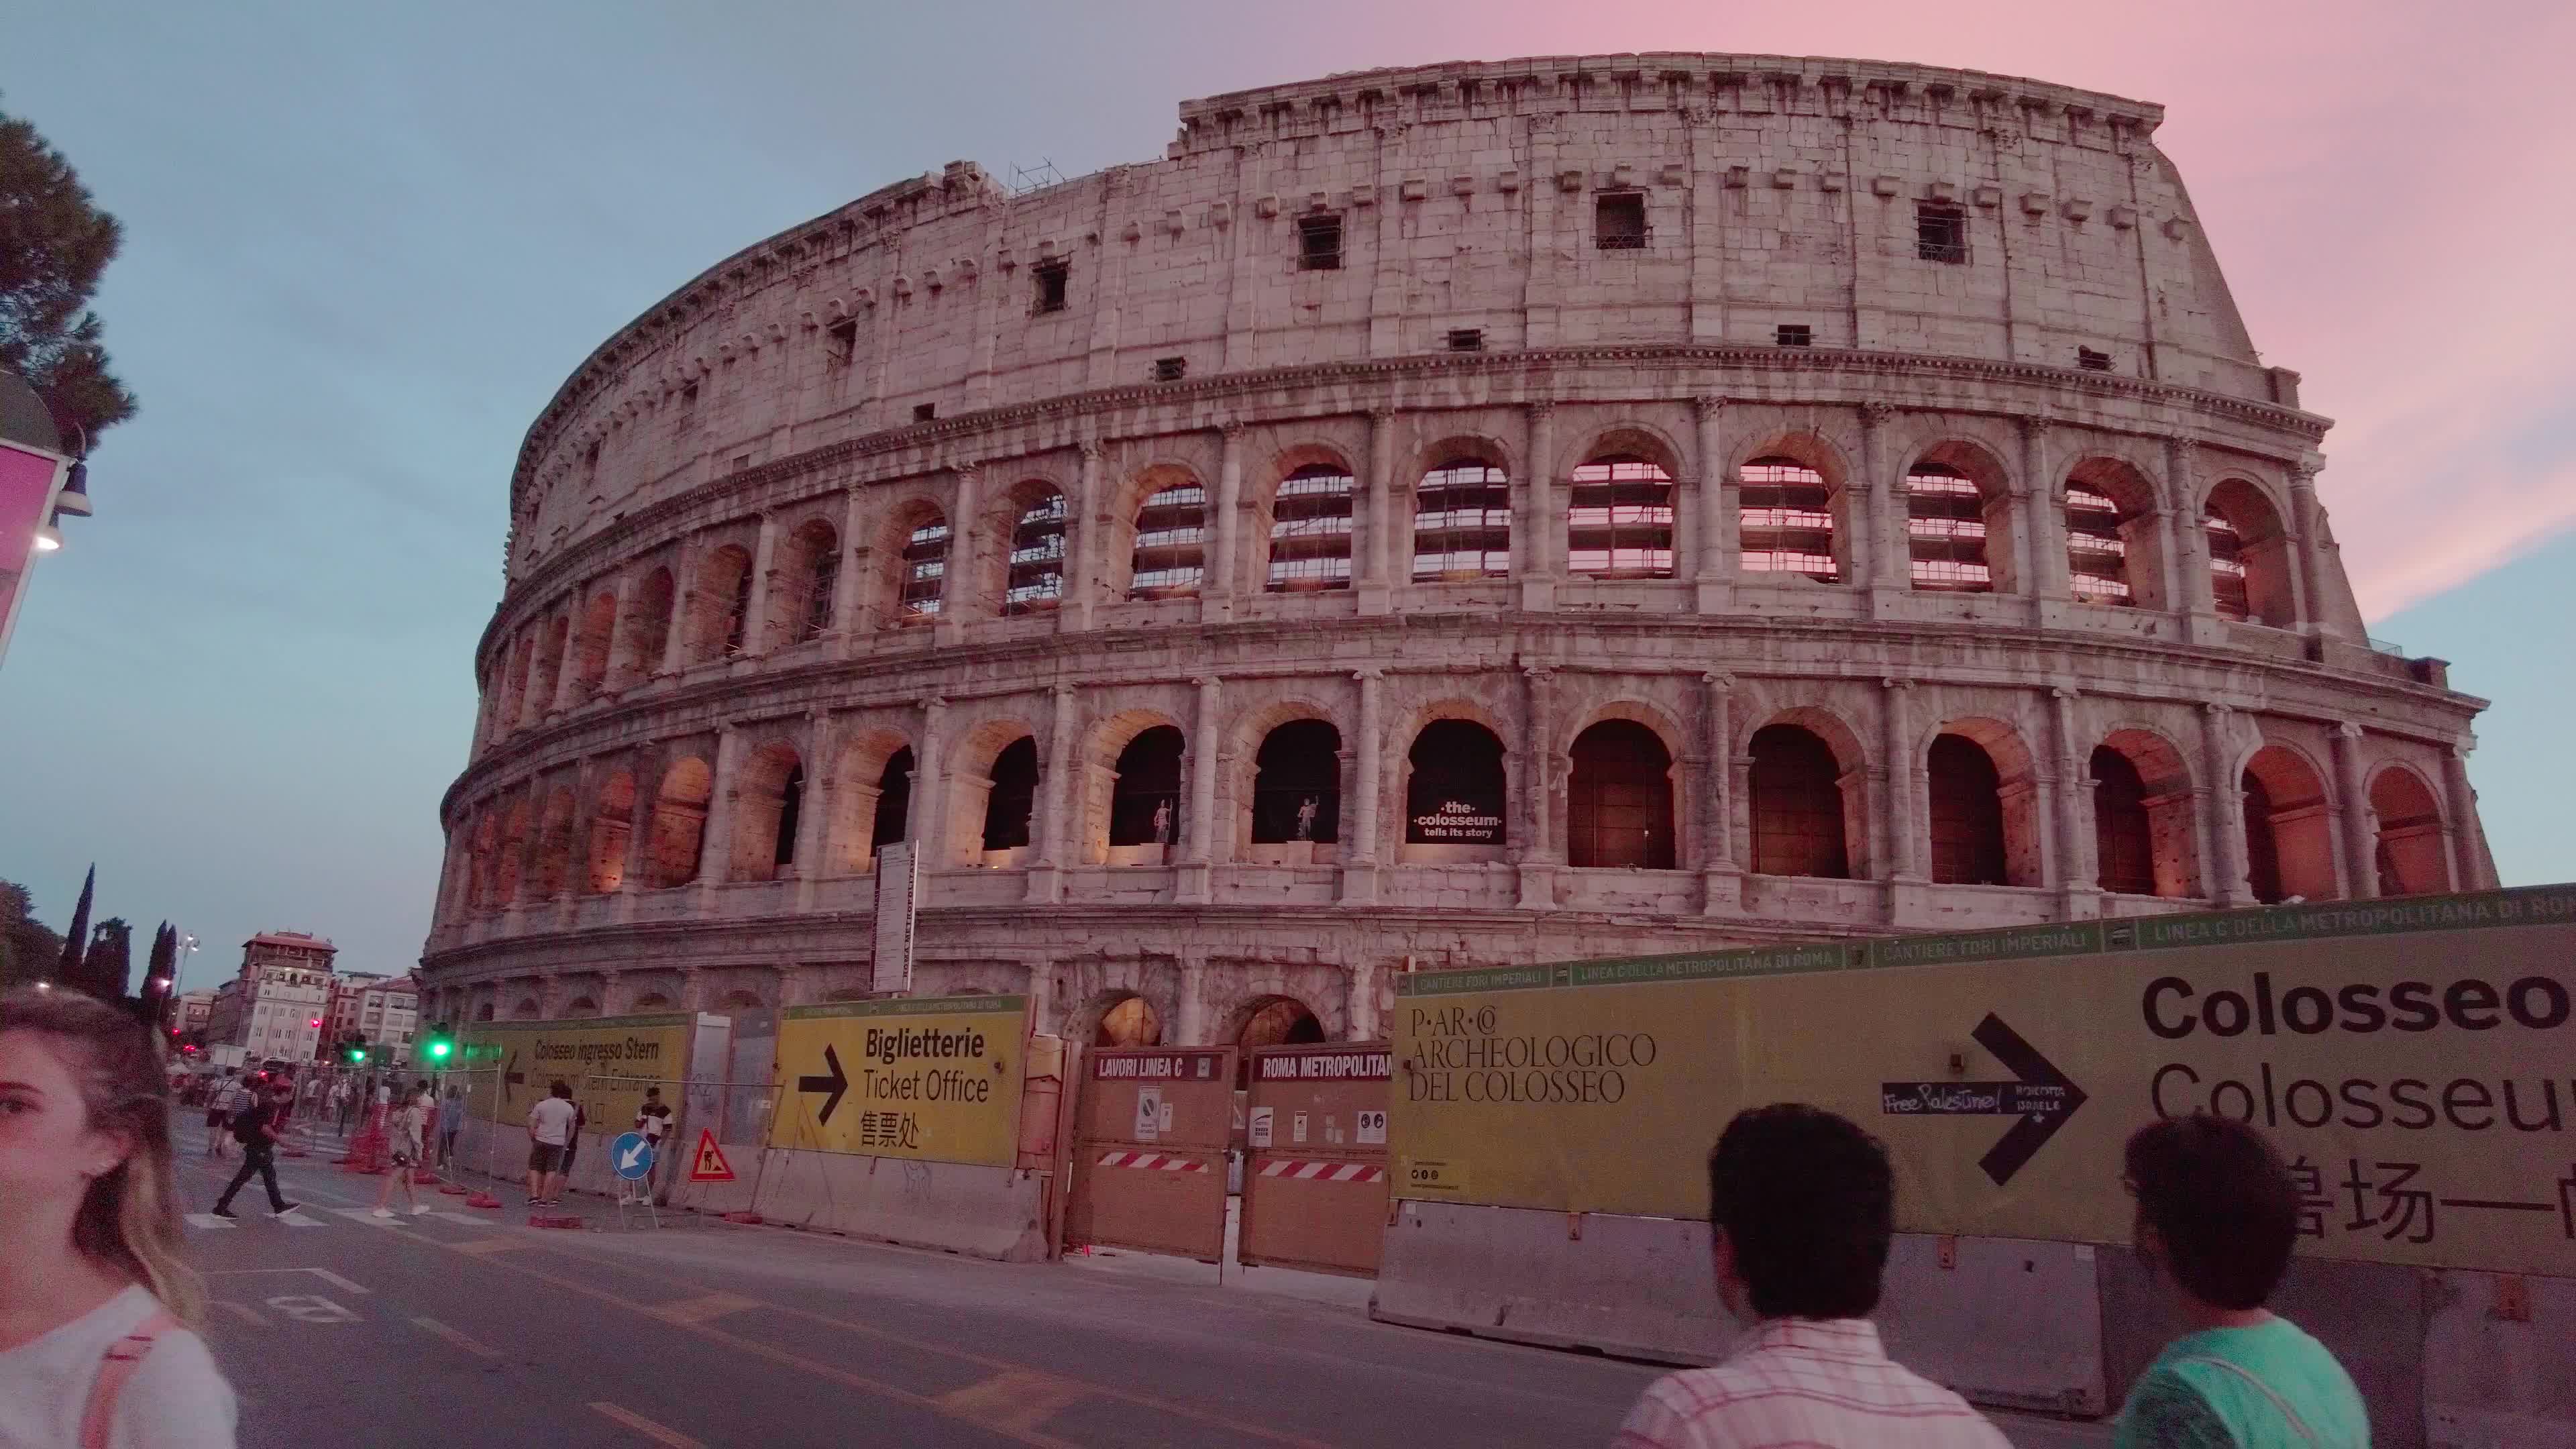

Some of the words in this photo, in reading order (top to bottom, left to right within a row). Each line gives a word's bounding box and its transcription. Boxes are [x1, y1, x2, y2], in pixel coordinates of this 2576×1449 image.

[1424, 828, 1447, 837] tells
[1449, 828, 1463, 837] its
[1465, 828, 1493, 839] story
[2154, 922, 2210, 941] LINEA
[2233, 912, 2298, 934] DELLA
[2300, 902, 2491, 932] METROPOLITANA
[2498, 900, 2523, 918] DI
[1884, 942, 1959, 962] CANTIERE
[1960, 938, 1996, 955] FORI
[2001, 933, 2086, 952] IMPERIALI
[1580, 965, 1614, 980] LINEA
[1627, 961, 1664, 977] DELLA
[1666, 955, 1772, 977] METROPOLITANA
[1776, 953, 1790, 967] DI
[1792, 950, 1833, 967] ROMA
[1420, 975, 1464, 991] CANTIERE
[1466, 974, 1488, 987] FORI
[1490, 971, 1542, 986] IMPERIALI
[2142, 971, 2569, 1039] Colosseo
[535, 1039, 576, 1061] Colosseo
[578, 1038, 623, 1065] ingresso
[625, 1036, 659, 1060] Stern
[865, 1026, 984, 1065] Biglietterie
[1411, 1033, 1656, 1069] ARCHEOLOGICO
[1099, 1059, 1137, 1077] LAVORI
[1139, 1058, 1173, 1077] LINEA
[1175, 1057, 1183, 1077] C
[1263, 1057, 1297, 1077] ROMA
[863, 1069, 920, 1100] Ticket
[926, 1069, 989, 1103] Office
[1410, 1071, 1459, 1102] DEL
[1465, 1070, 1625, 1103] COLOSSEO
[2151, 1062, 2576, 1131] Colosseu
[1883, 1093, 1920, 1112] Free
[860, 1110, 920, 1150] 售票处
